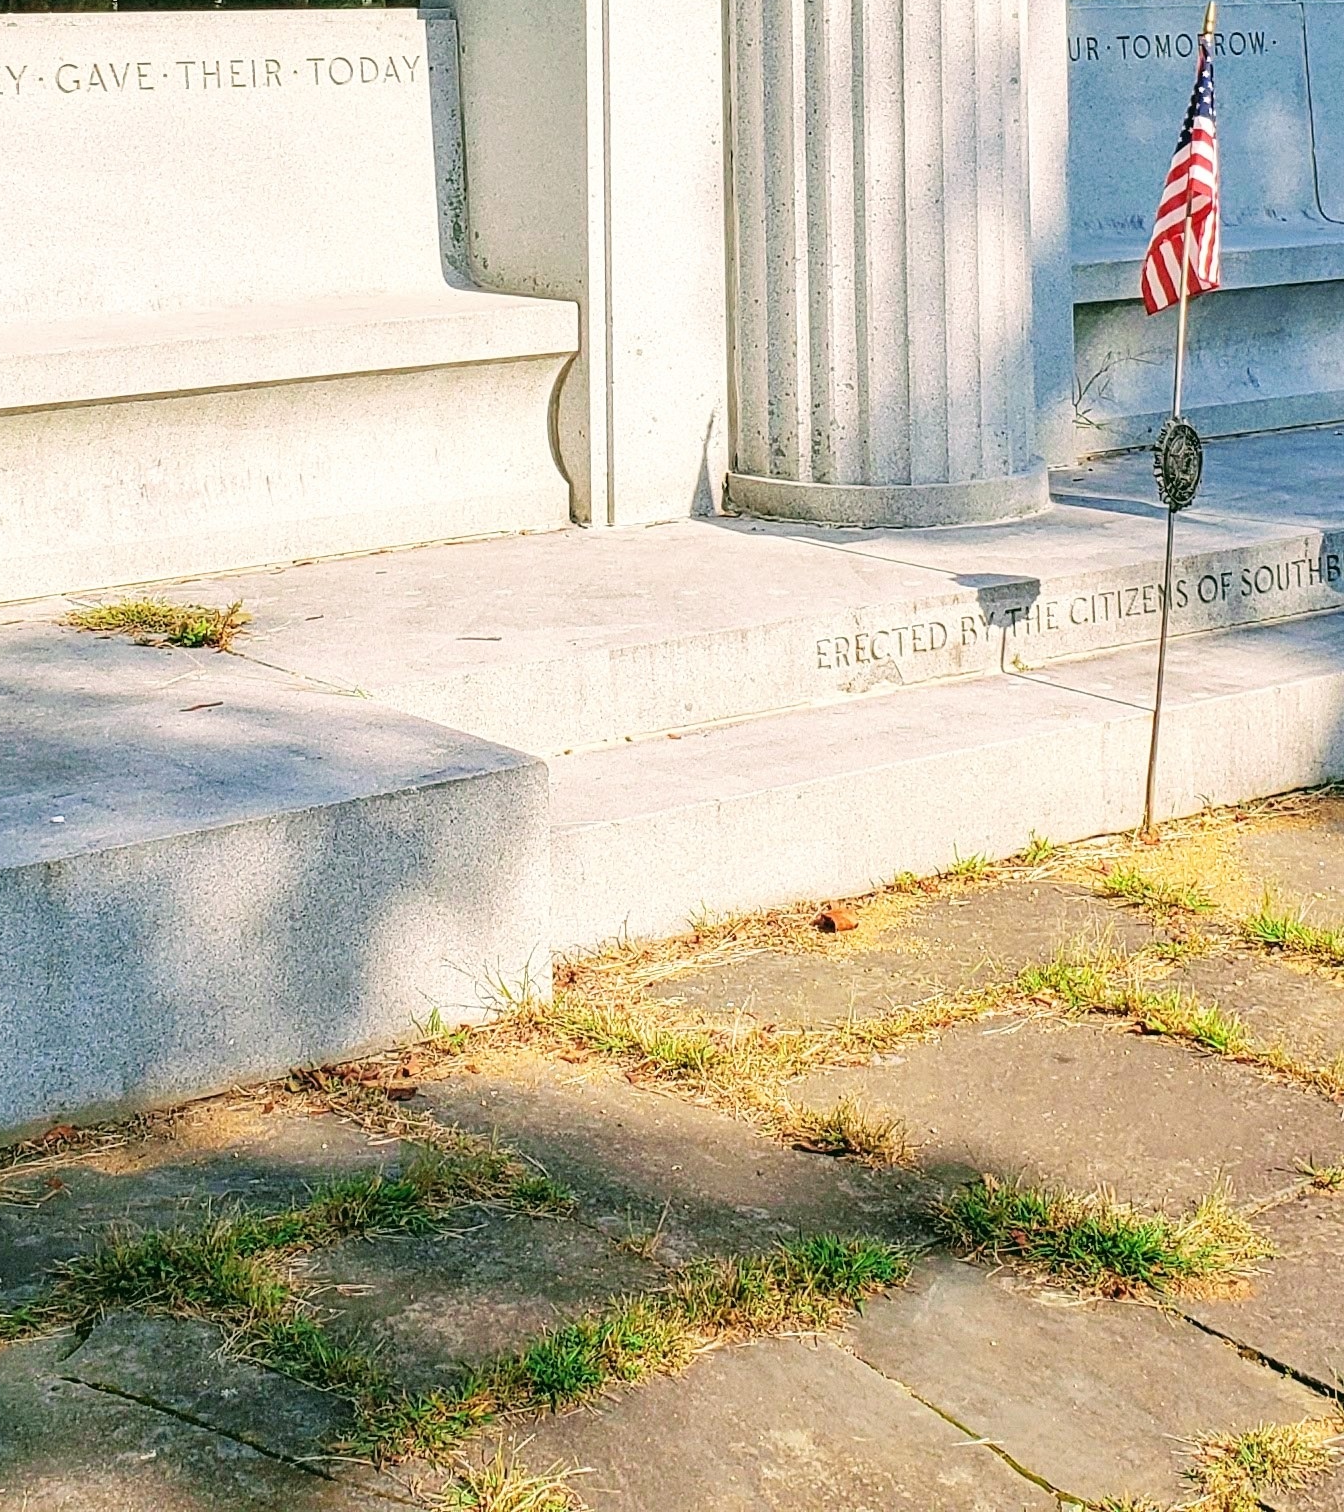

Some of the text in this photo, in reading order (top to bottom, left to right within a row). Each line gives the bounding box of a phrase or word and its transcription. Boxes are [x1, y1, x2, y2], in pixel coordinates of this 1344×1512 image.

[55, 61, 156, 94] GAVE
[175, 58, 283, 90] THEIR
[306, 55, 422, 86] TODAY
[816, 621, 947, 670] ERECTED
[960, 612, 994, 647] BY
[1005, 601, 1059, 638] THE
[1069, 579, 1189, 626] CITIZENS
[1197, 571, 1233, 603] OF
